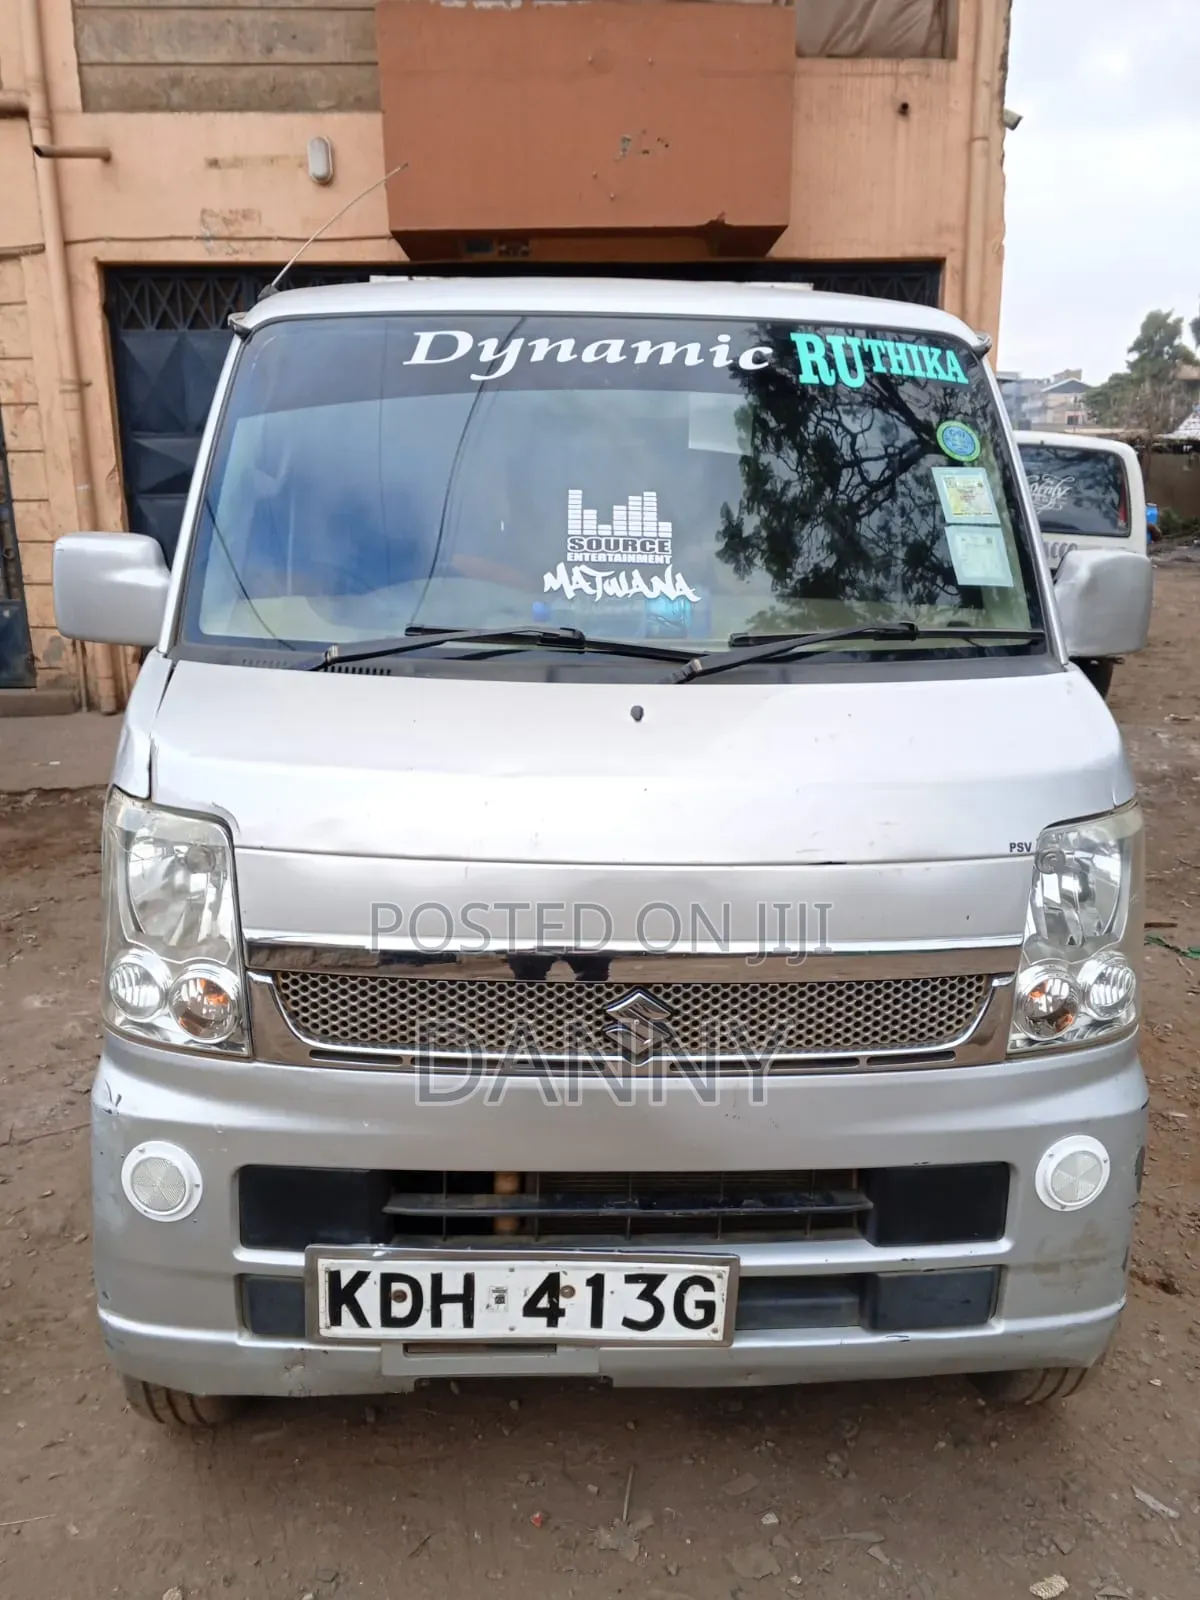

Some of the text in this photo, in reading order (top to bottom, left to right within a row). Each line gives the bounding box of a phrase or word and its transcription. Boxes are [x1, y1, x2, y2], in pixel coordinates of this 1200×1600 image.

[403, 331, 773, 382] Dynamic
[789, 331, 969, 388] RUTHIKA
[566, 552, 673, 564] ENTERTAINMENT
[567, 536, 673, 555] SOURCE
[1009, 841, 1032, 853] PSV
[327, 1270, 475, 1329] KDH
[522, 1271, 718, 1333] 413G
